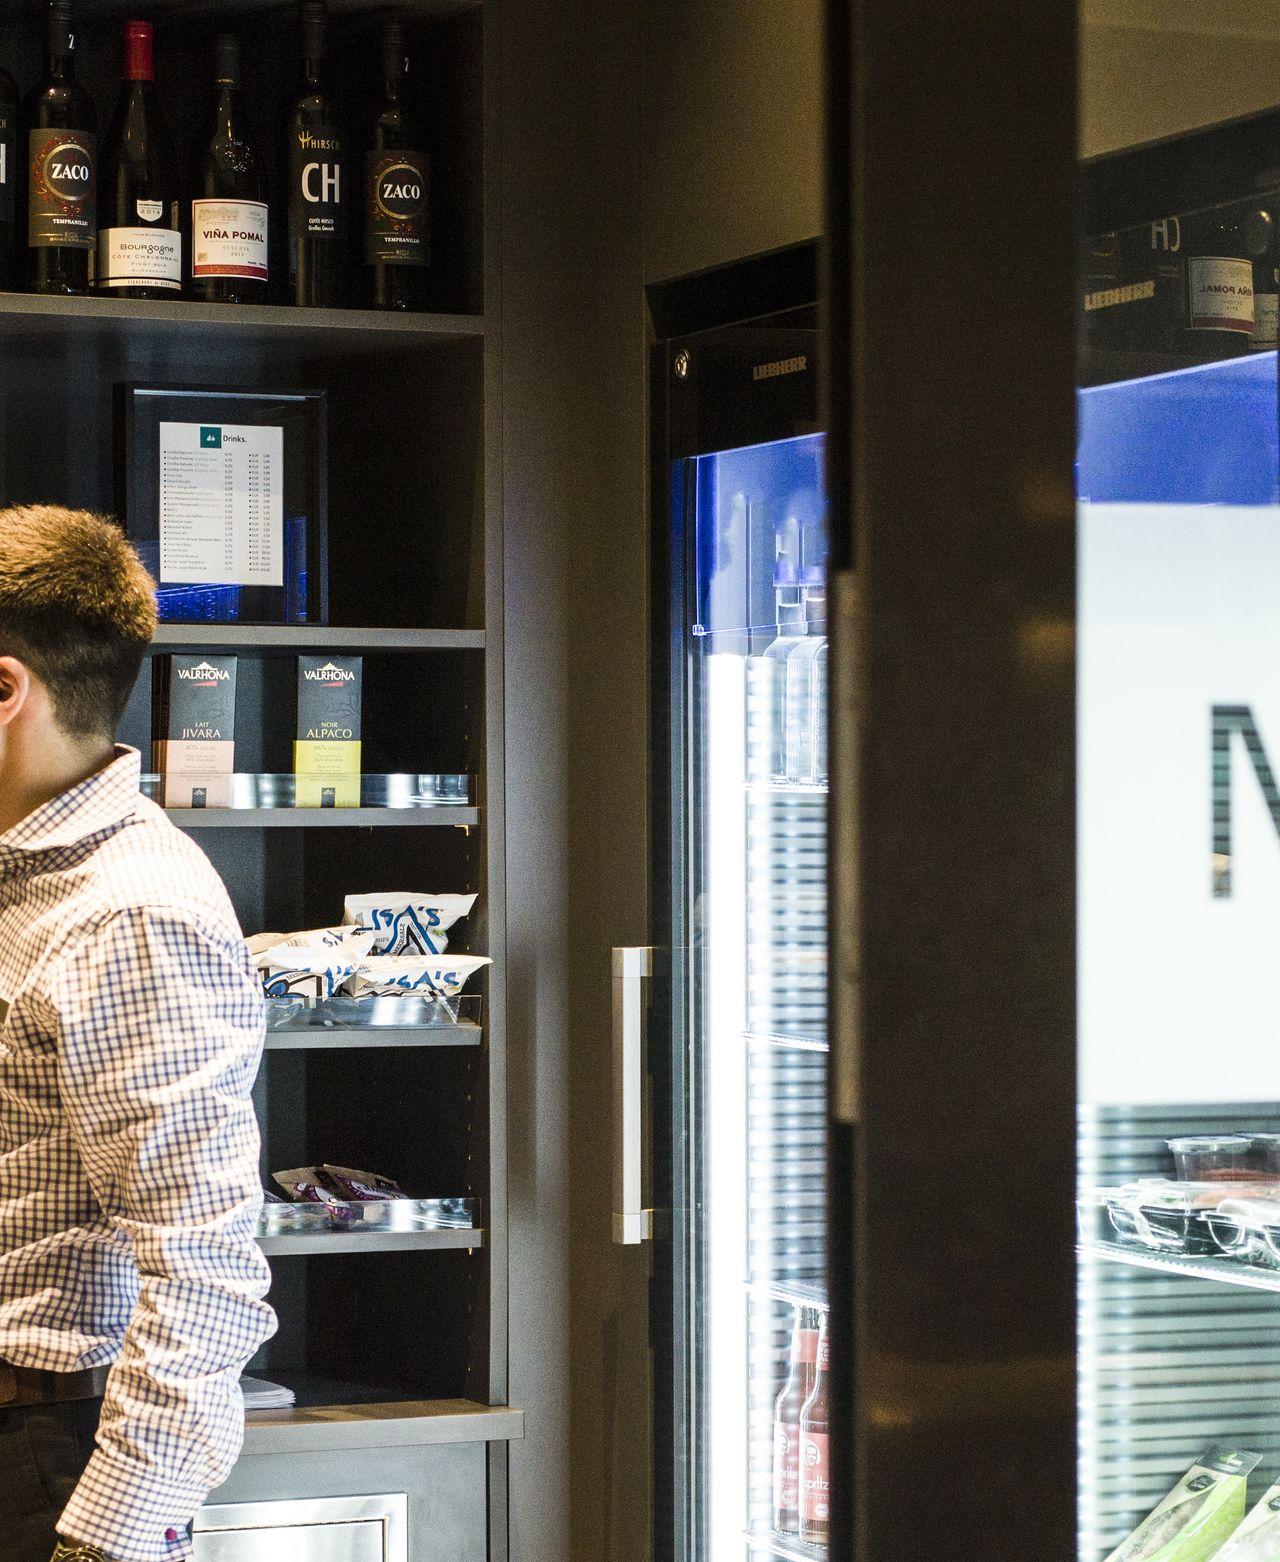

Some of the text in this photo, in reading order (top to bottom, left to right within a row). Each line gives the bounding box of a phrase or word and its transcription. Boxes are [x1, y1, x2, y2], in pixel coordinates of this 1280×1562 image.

[51, 163, 89, 181] ZACO
[301, 162, 340, 203] CH
[383, 183, 420, 200] ZACO
[203, 228, 264, 243] VIÑA POMAL
[222, 434, 247, 443] Drinks.
[178, 668, 230, 681] VALRHONA
[304, 669, 355, 682] VALRHONA
[181, 728, 221, 739] JIVARA
[306, 728, 352, 739] ALPACO
